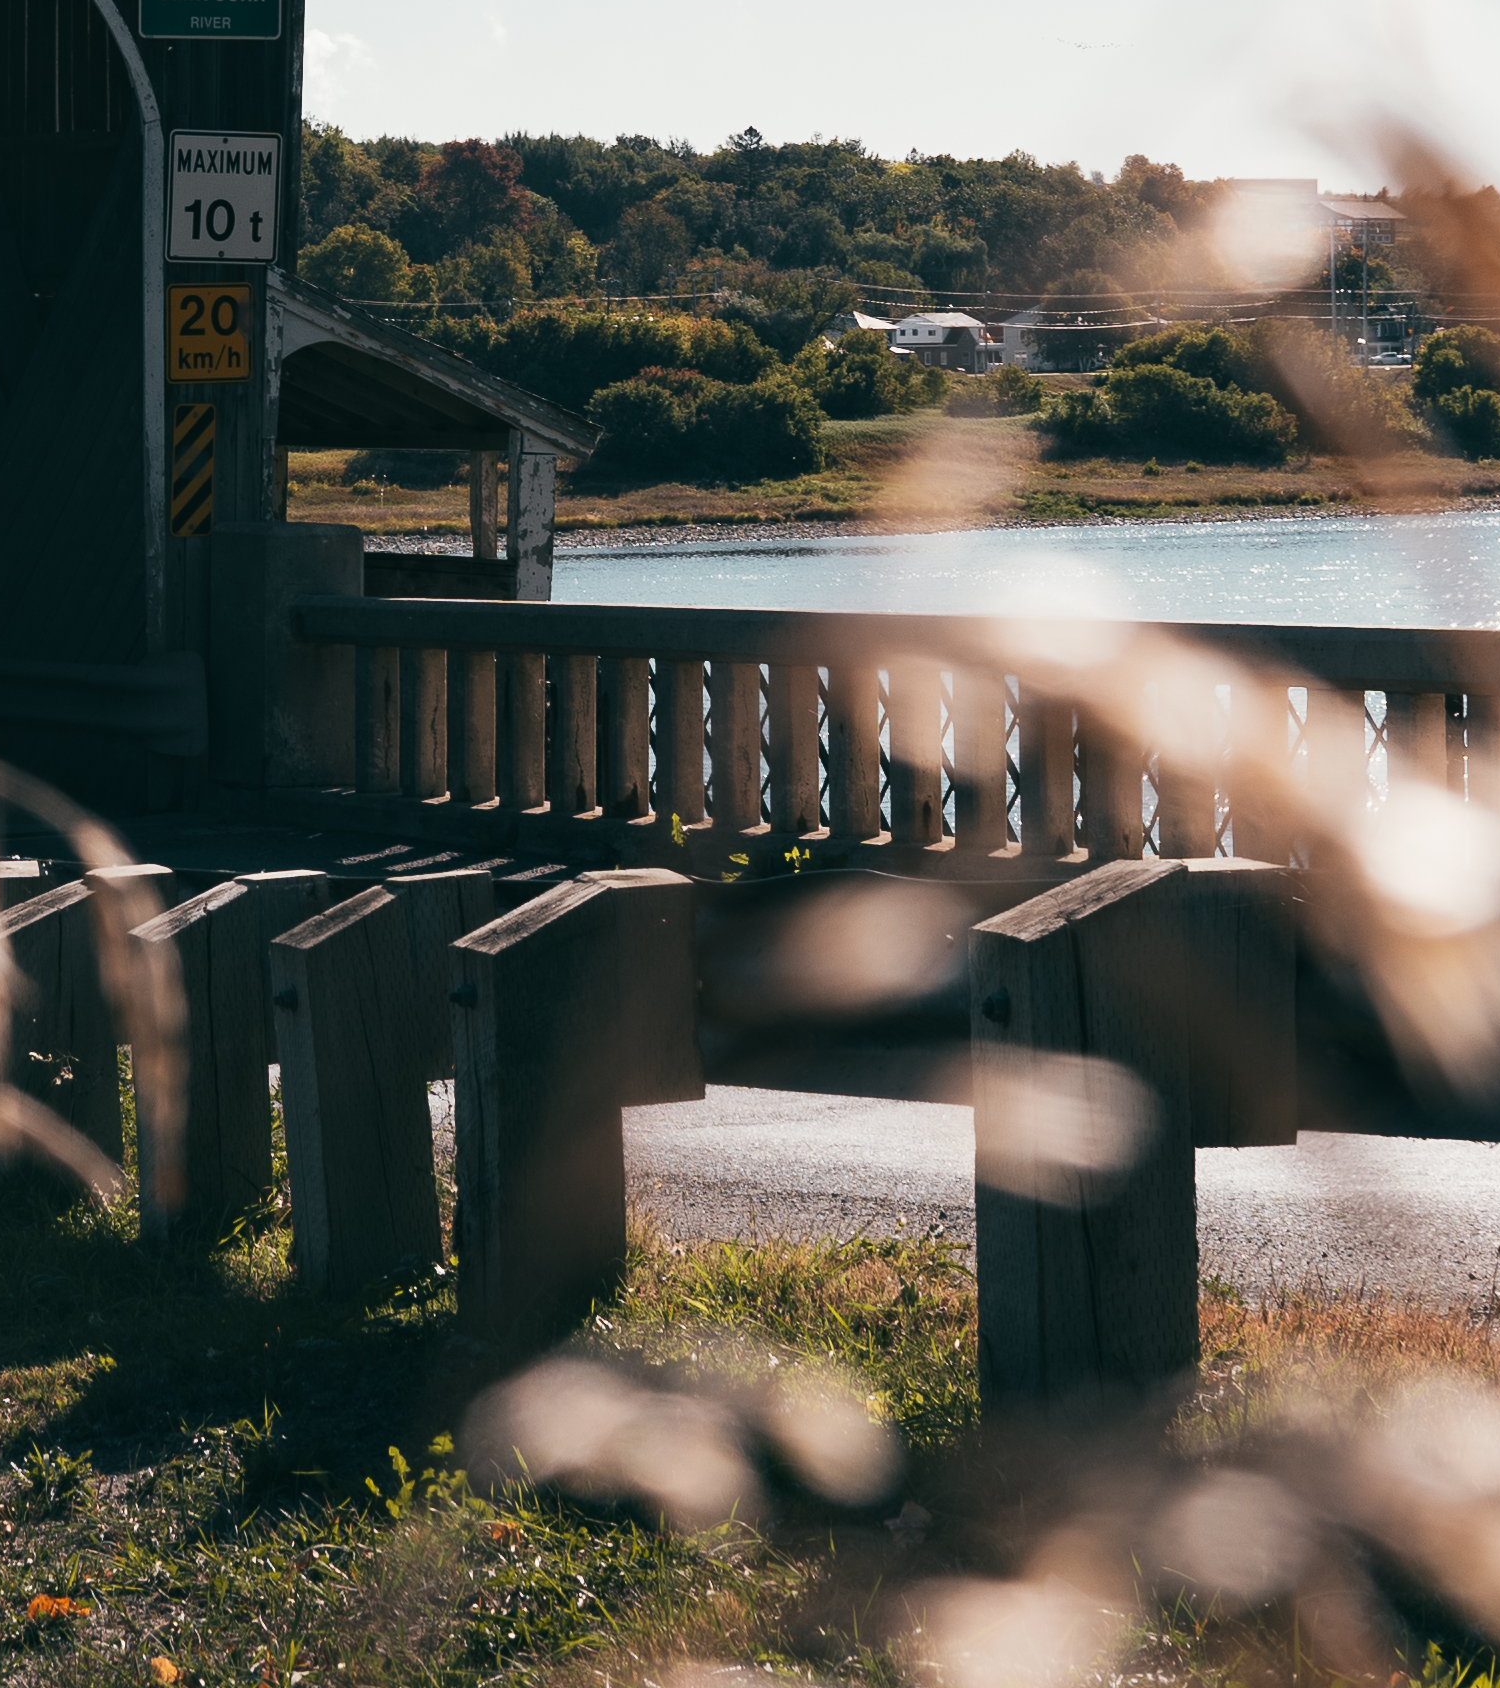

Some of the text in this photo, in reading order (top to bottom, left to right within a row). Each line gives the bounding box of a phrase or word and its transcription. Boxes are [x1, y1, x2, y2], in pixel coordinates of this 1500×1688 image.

[190, 16, 231, 29] RIVER
[178, 149, 272, 175] MAXIMUM
[185, 199, 263, 242] 10 t
[180, 295, 238, 336] 20
[178, 345, 240, 370] km/h
